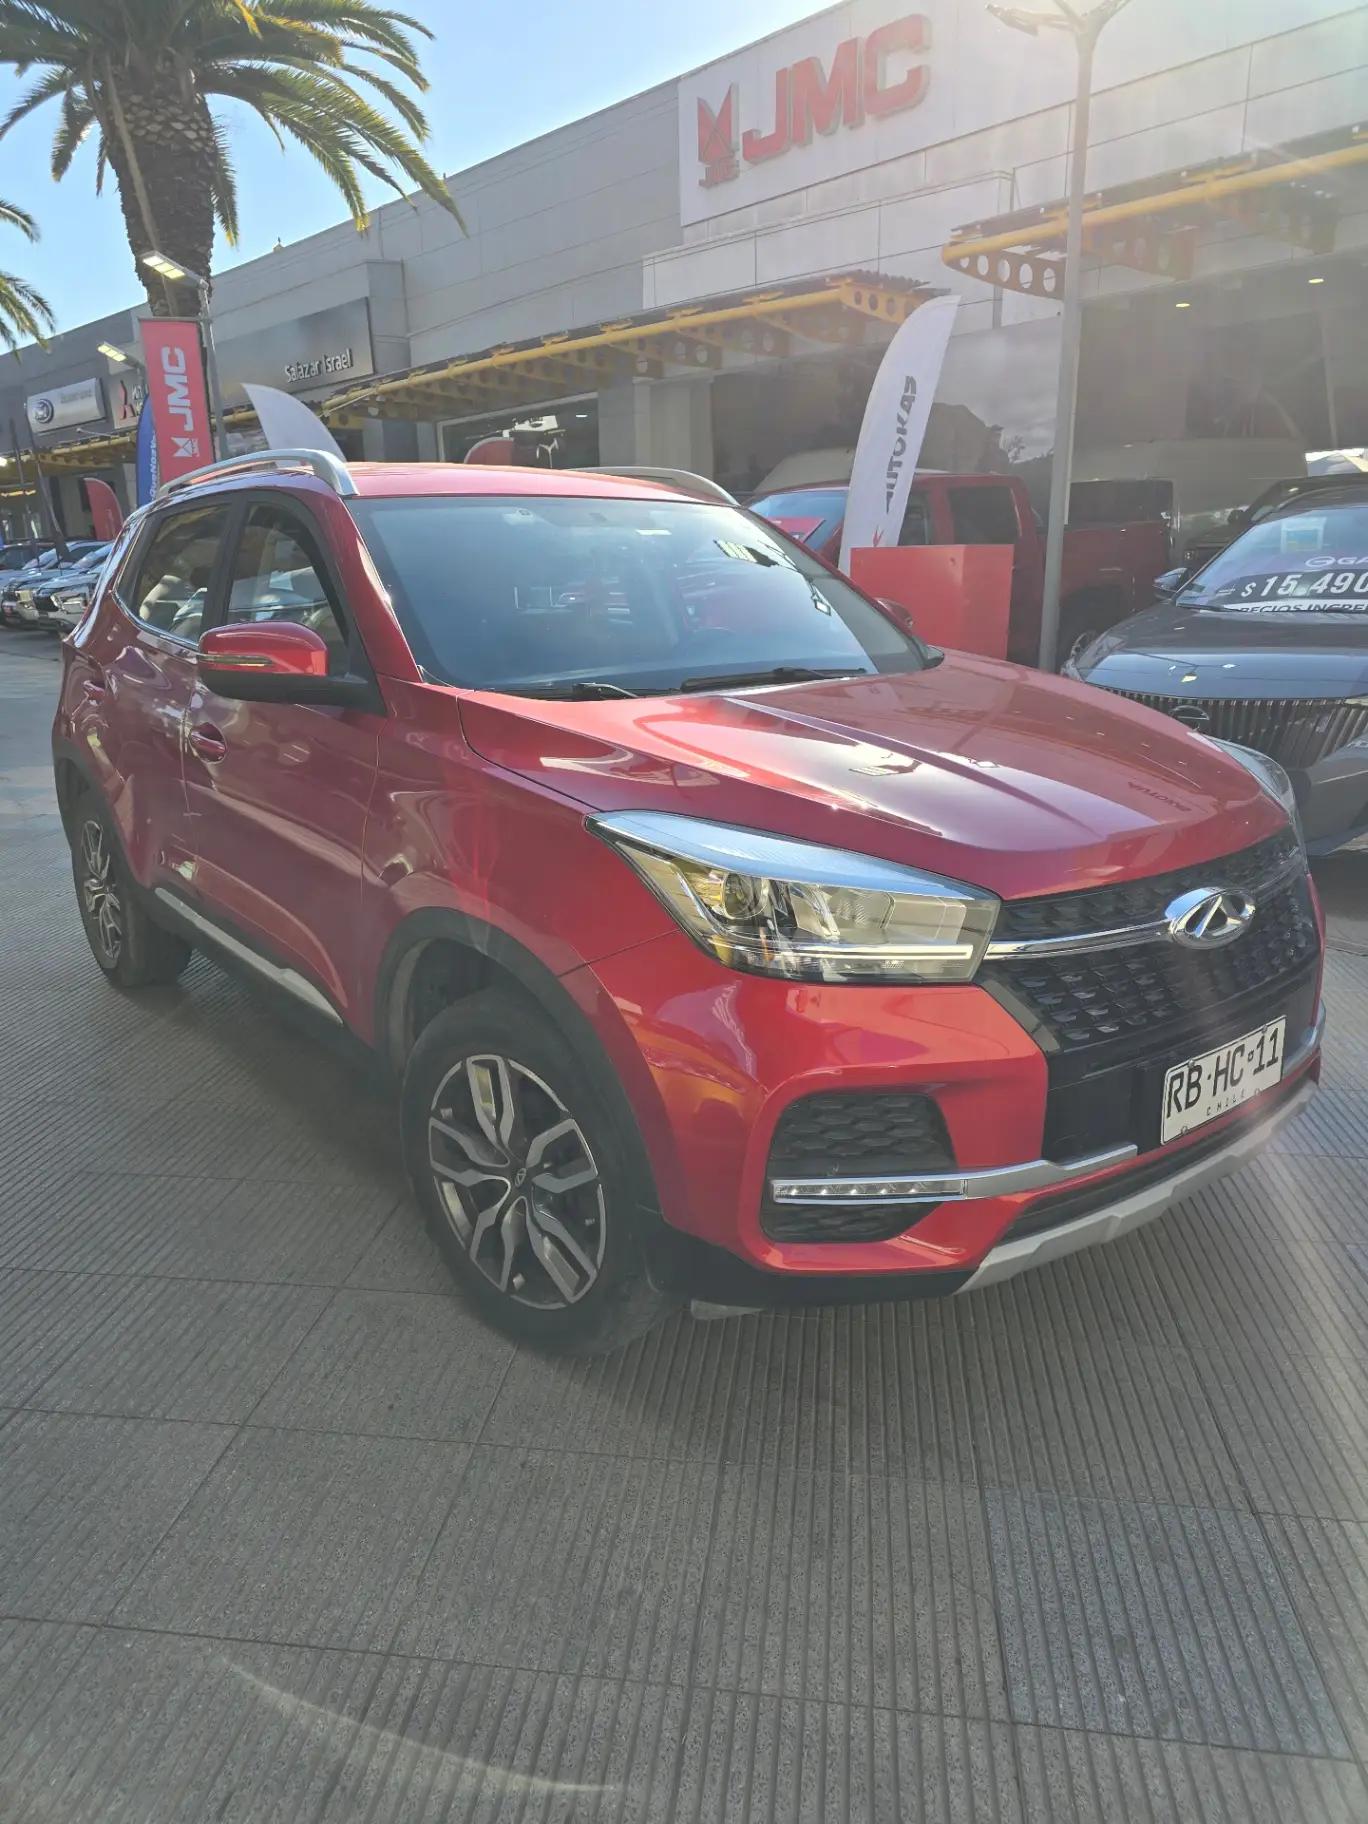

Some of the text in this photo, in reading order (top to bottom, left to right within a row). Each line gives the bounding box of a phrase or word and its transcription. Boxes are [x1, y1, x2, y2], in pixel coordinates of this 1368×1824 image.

[742, 13, 931, 165] JMC
[160, 346, 195, 432] JMC
[284, 347, 353, 383] Salazar Israel
